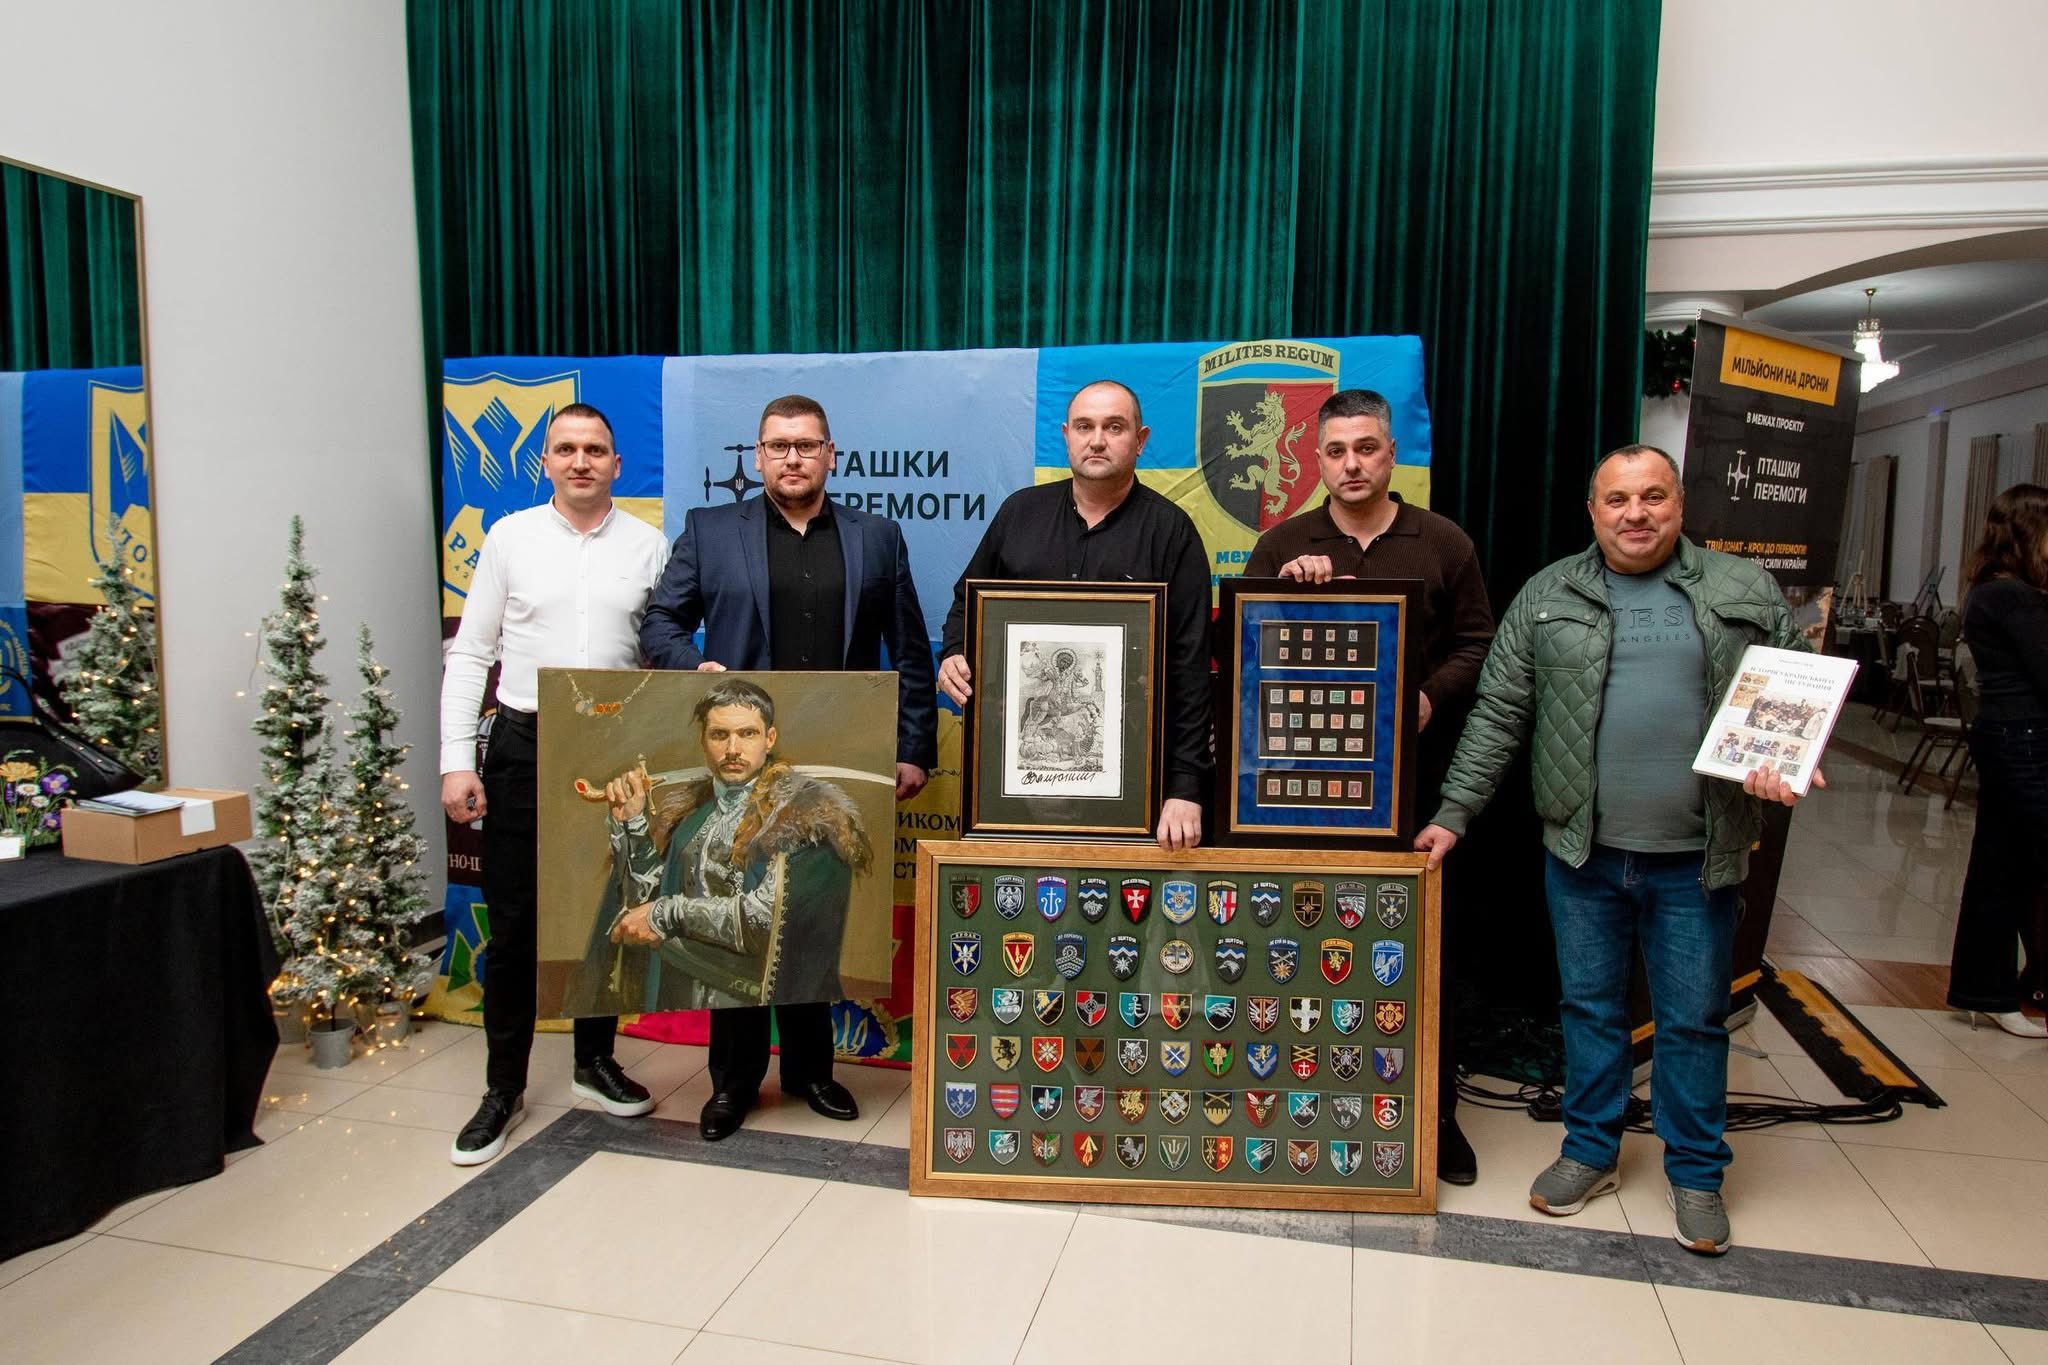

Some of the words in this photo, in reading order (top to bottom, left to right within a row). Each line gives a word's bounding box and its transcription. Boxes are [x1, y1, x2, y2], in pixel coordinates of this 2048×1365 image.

[1204, 344, 1273, 373] MILITES
[1275, 344, 1335, 369] REGUM
[1732, 356, 1784, 382] МІЛЬЙОНИ
[1784, 368, 1797, 386] НА
[1797, 372, 1830, 393] ДРОНИ
[1746, 411, 1752, 423] В
[1751, 413, 1776, 428] МЕЖАХ
[831, 450, 949, 477] ТАШКИ
[1756, 457, 1801, 479] ПТАШКИ
[1753, 482, 1807, 504] ПЕРЕМОГИ
[826, 492, 985, 521] РЕМОГИ
[1747, 542, 1765, 553] КРОК
[1765, 543, 1775, 555] ДО
